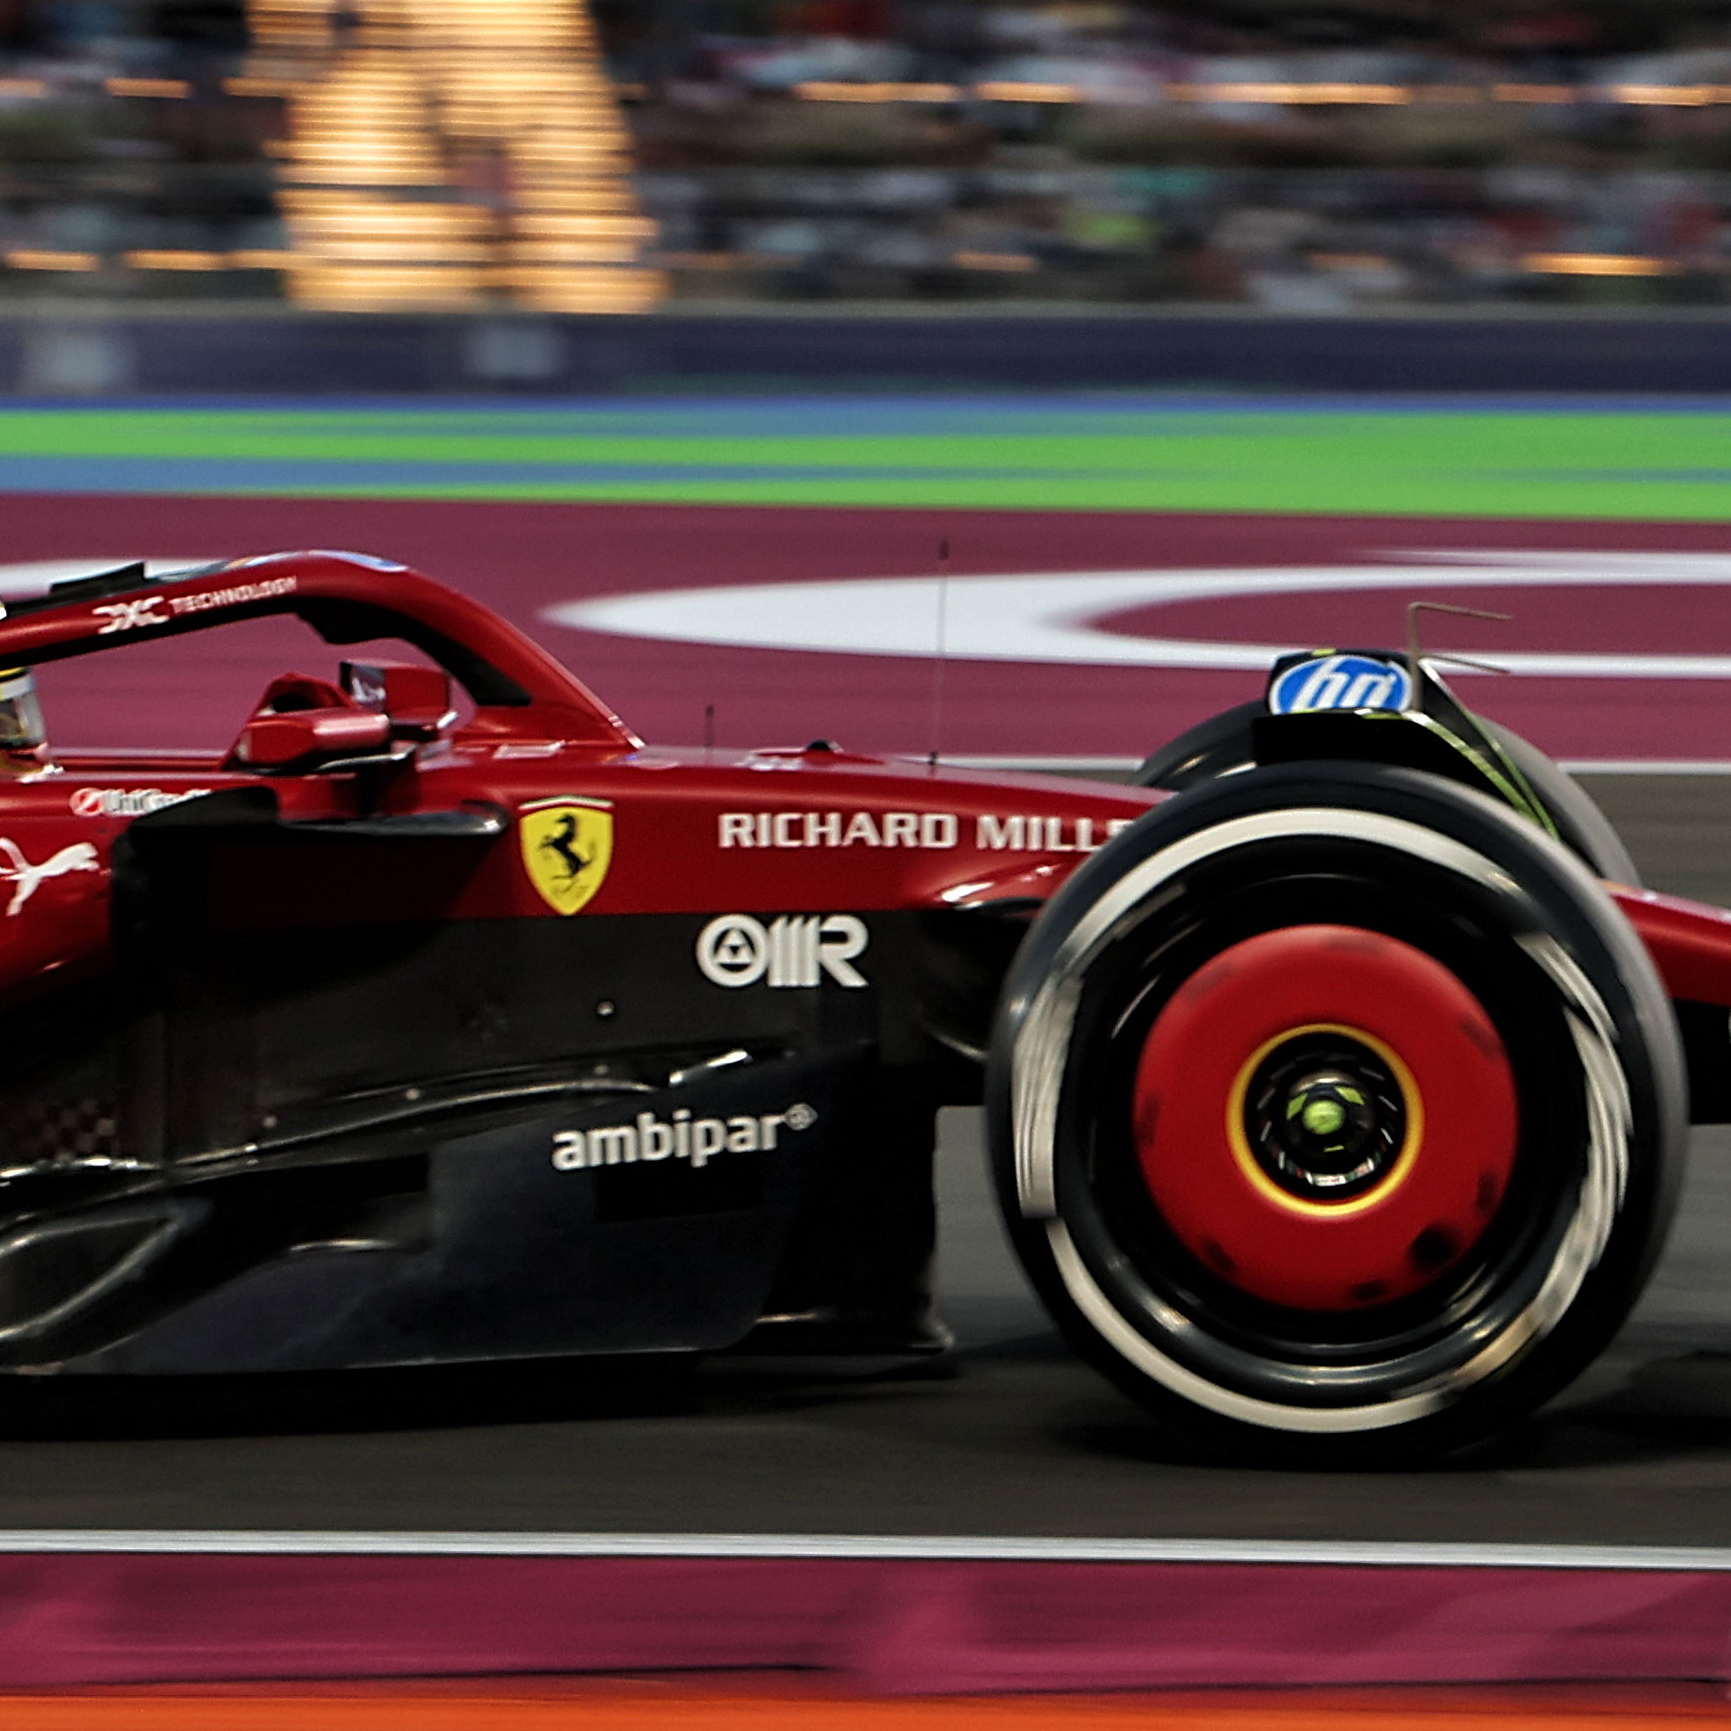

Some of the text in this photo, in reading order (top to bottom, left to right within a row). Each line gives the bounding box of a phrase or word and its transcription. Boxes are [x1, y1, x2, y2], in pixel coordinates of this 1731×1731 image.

[168, 576, 297, 614] TECHNOLOGY
[719, 812, 958, 849] RICHARD
[551, 1109, 786, 1170] ambipar
